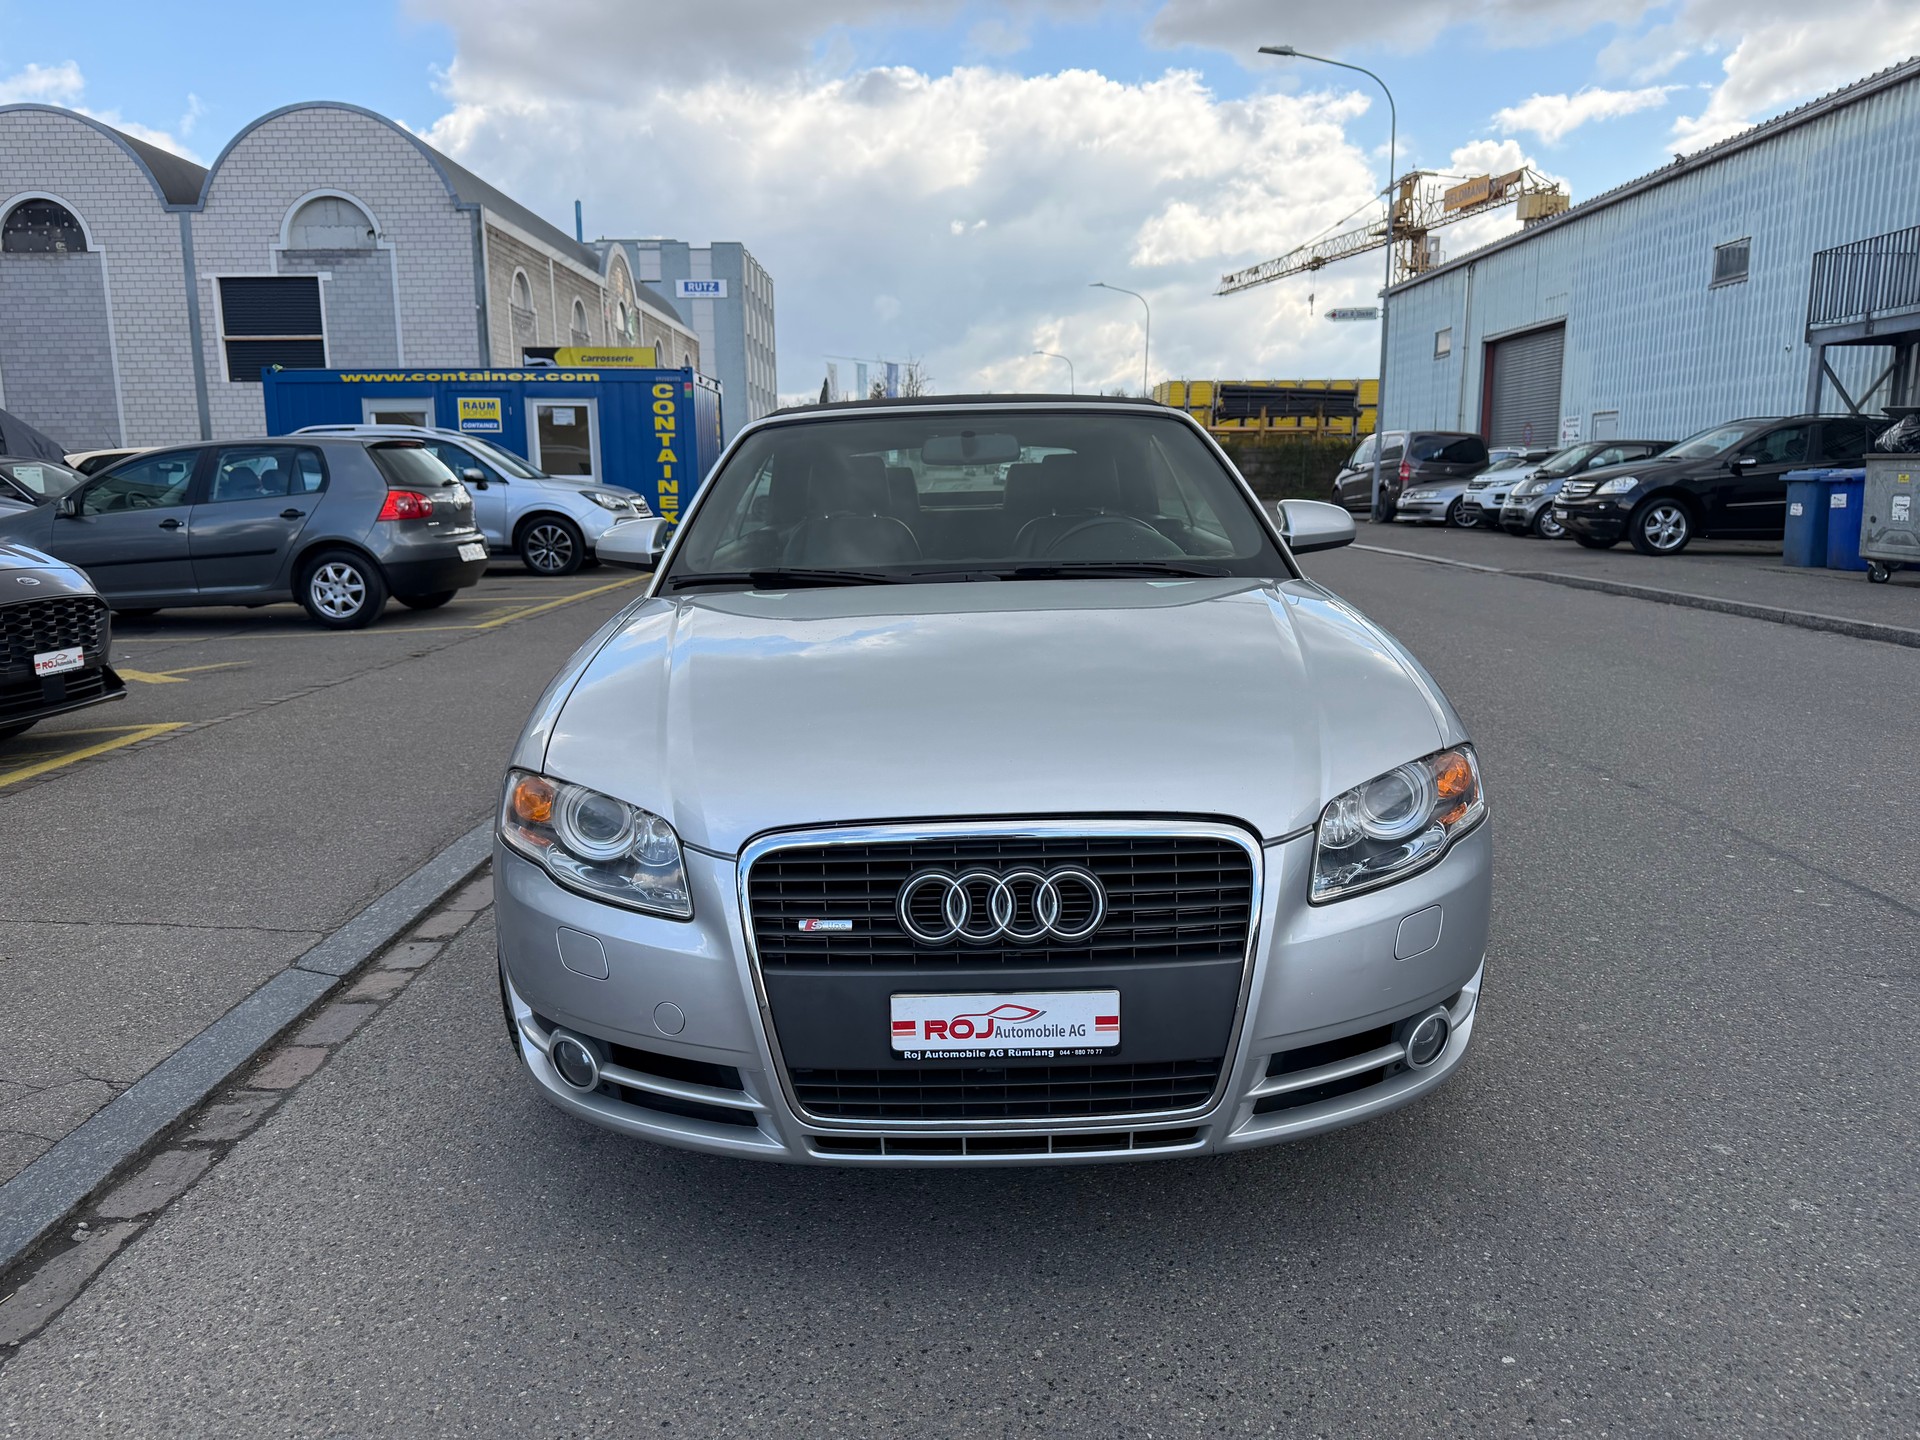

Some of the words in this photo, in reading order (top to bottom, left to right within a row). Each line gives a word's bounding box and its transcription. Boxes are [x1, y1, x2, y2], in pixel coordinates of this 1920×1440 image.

[687, 282, 716, 292] RUTZ
[581, 355, 634, 363] Carrosserie
[340, 371, 600, 382] www.containex.com
[463, 401, 496, 411] RAUM
[652, 383, 679, 525] CONTAINEX
[42, 659, 58, 670] ROJ
[924, 1018, 994, 1041] ROJ
[994, 1024, 1066, 1040] Automobile
[1068, 1024, 1086, 1037] AG
[904, 1050, 921, 1060] Roj
[925, 1049, 986, 1058] Automobile
[988, 1049, 1004, 1057] AG
[1008, 1048, 1054, 1058] Rümlang
